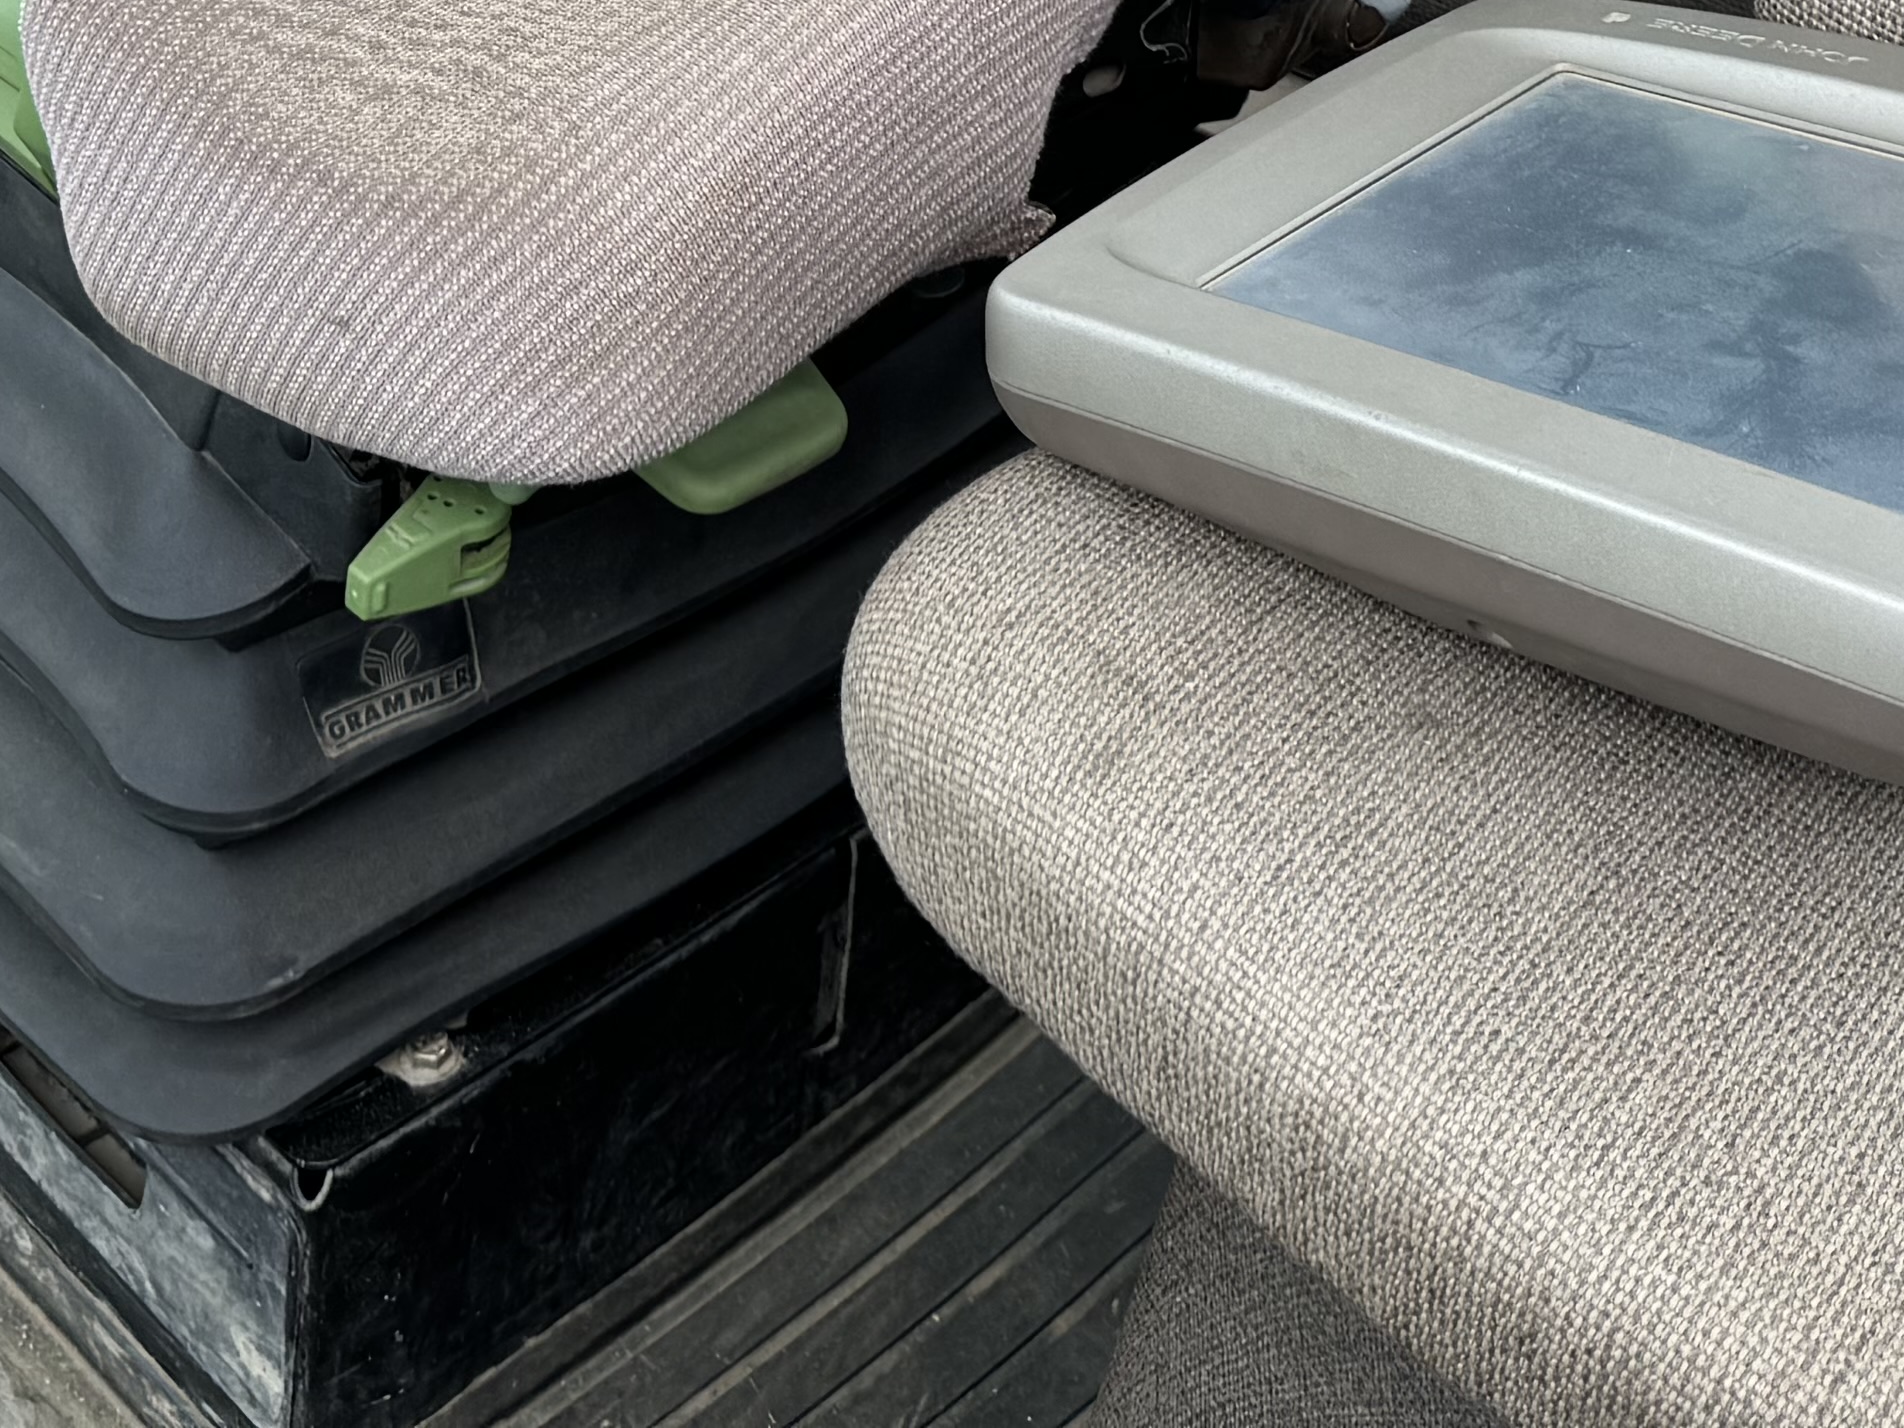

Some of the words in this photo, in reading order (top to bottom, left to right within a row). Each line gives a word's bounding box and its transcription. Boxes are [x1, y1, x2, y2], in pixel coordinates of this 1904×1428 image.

[1645, 17, 1767, 50] DEERE
[1766, 38, 1871, 66] JOHN
[327, 662, 473, 741] GRAMMER
